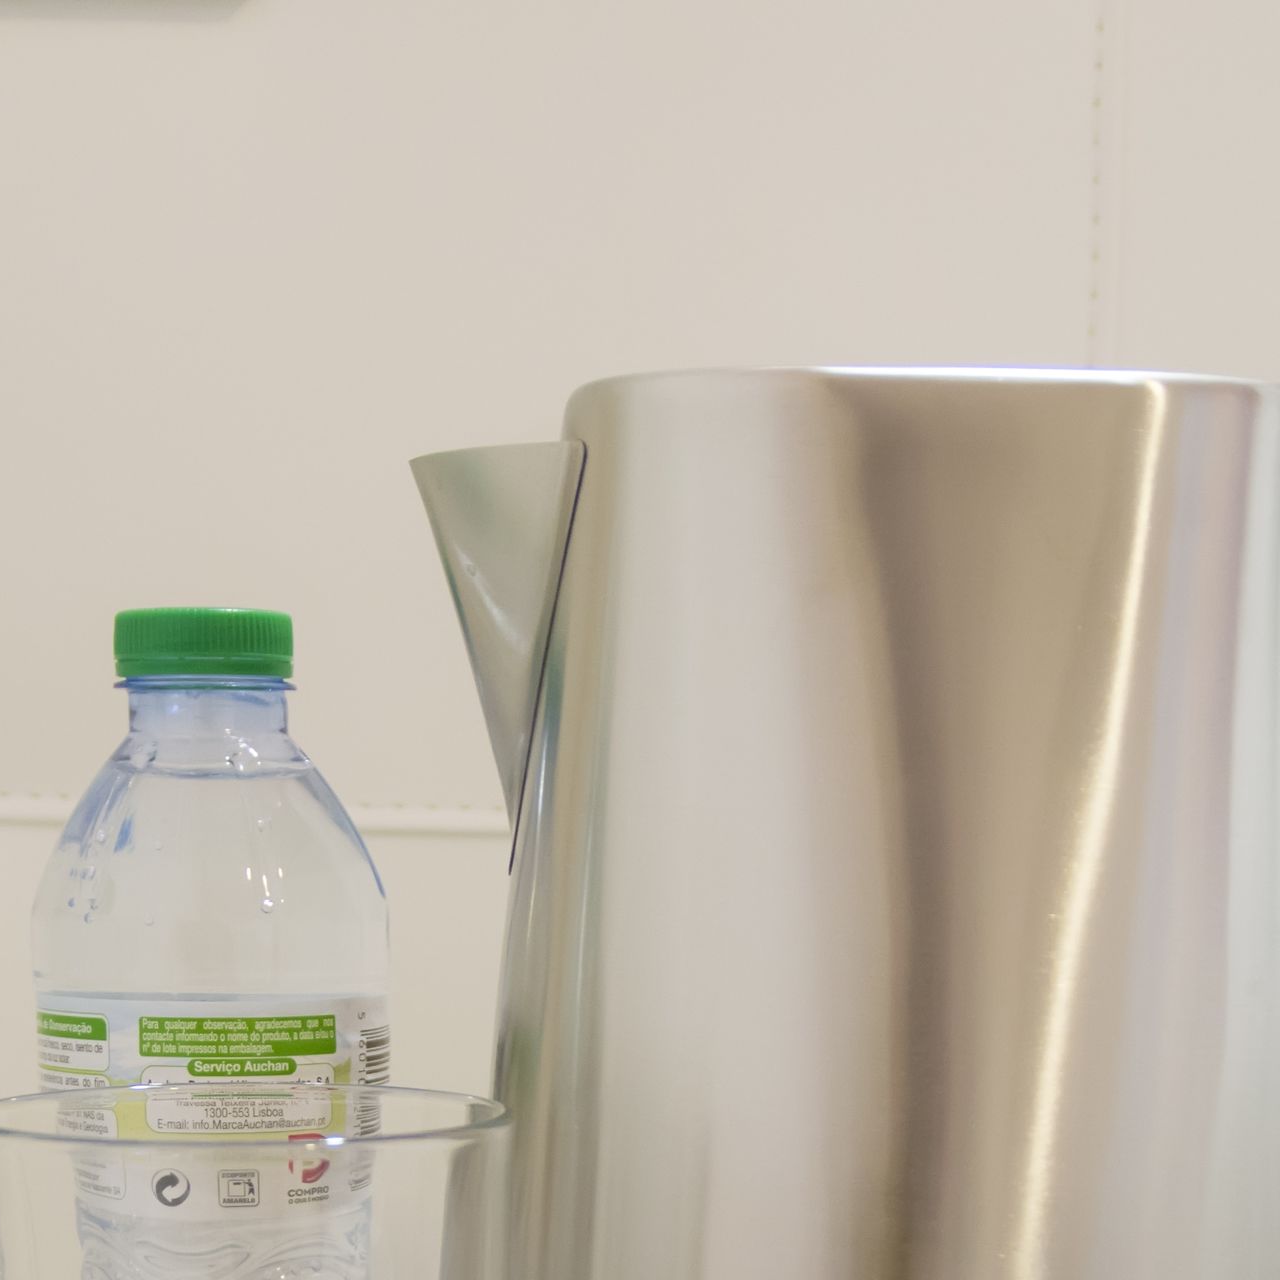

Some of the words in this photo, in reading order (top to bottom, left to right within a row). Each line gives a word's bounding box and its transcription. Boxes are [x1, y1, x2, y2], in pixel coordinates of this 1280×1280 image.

[142, 1018, 159, 1029] Para
[164, 1020, 197, 1032] qualquer
[202, 1019, 249, 1031] observação,
[175, 1031, 218, 1042] informando
[227, 1032, 249, 1042] nome
[250, 1031, 260, 1042] do
[151, 1042, 161, 1053] de
[162, 1042, 177, 1053] lote
[177, 1042, 217, 1056] impressos
[229, 1042, 274, 1056] embalagem.
[194, 1060, 241, 1076] Serviço
[244, 1060, 289, 1072] Auchan
[204, 1107, 250, 1119] 1300-553
[252, 1106, 284, 1118] Lisboa
[157, 1118, 190, 1131] E-mail:
[287, 1186, 330, 1198] COMPRO
